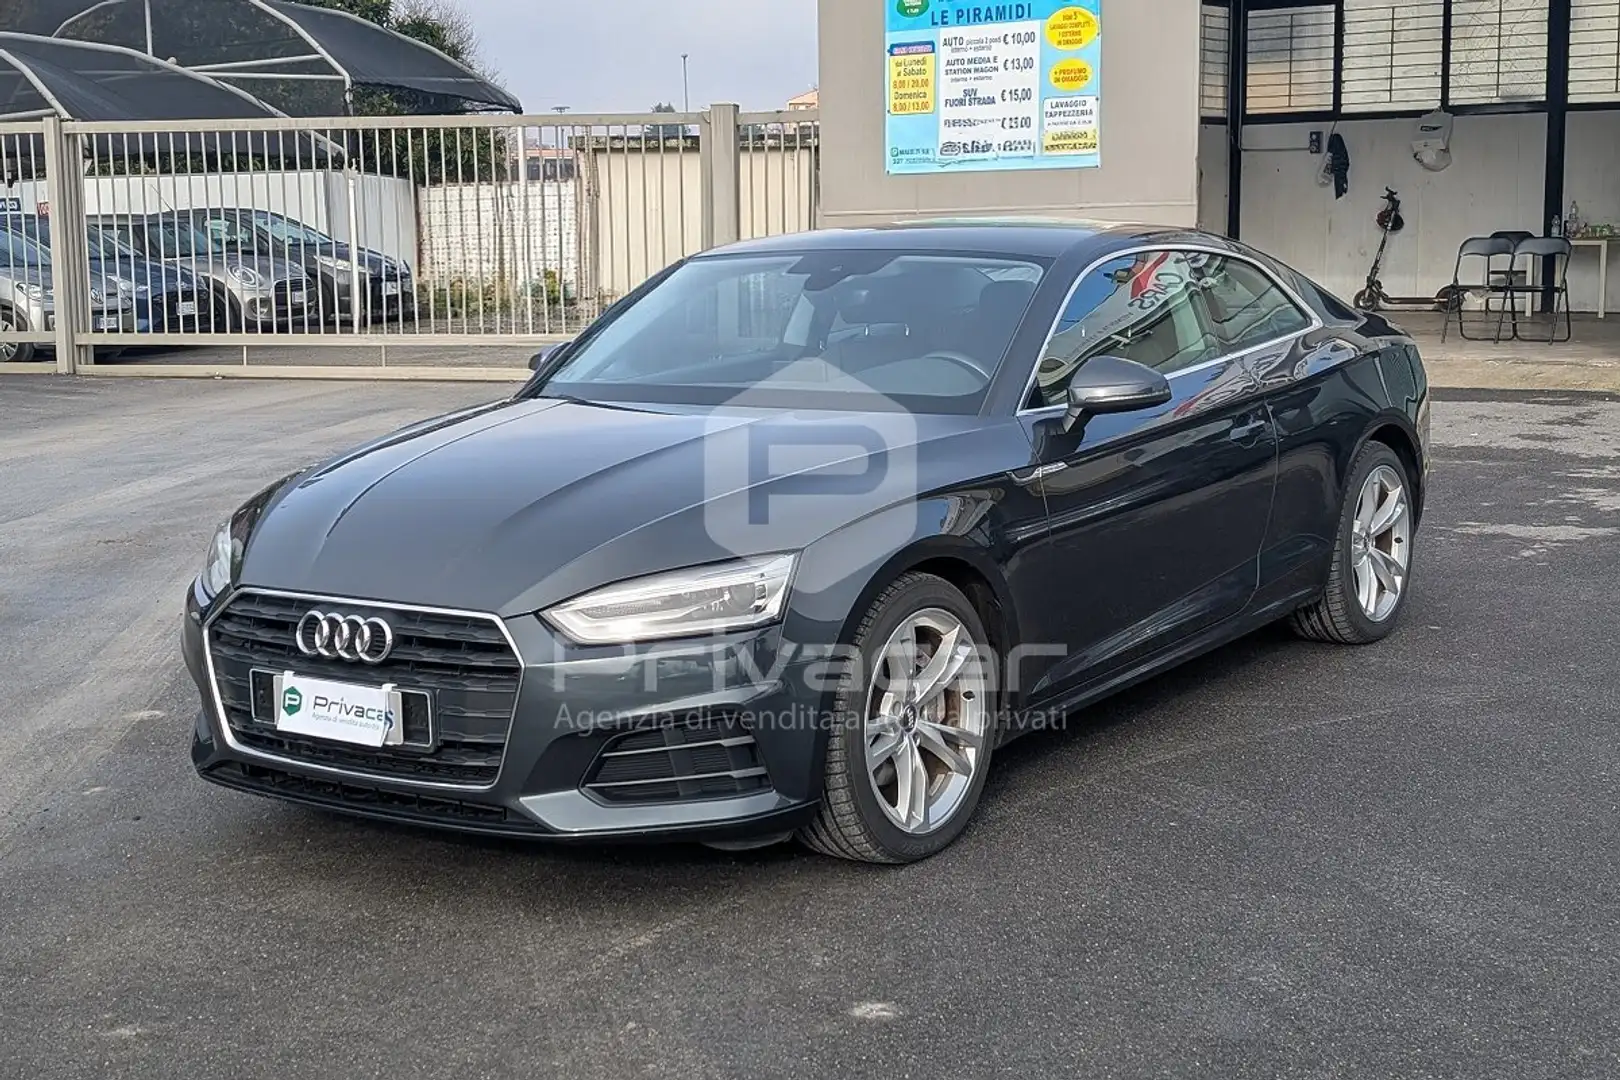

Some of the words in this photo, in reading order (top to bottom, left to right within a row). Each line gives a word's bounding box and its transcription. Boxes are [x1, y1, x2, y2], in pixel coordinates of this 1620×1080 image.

[931, 10, 949, 26] LE
[956, 3, 1032, 24] PIRAMIDI
[942, 37, 964, 47] AUTO
[1003, 33, 1009, 45] €
[1011, 31, 1035, 46] 10,00
[945, 58, 965, 67] AUTO
[967, 56, 991, 65] MEDIA
[993, 55, 998, 63] E
[945, 67, 972, 75] STATION
[1003, 59, 1009, 71] €
[1011, 56, 1034, 72] 13,00
[894, 90, 927, 100] Domenica
[944, 98, 967, 108] FUORI
[968, 95, 996, 107] STRADA
[962, 88, 978, 97] SUV
[1001, 89, 1007, 102] €
[1008, 87, 1032, 103] 15,00
[1050, 100, 1087, 109] LAVAGGIO
[1045, 109, 1093, 118] TAPPEZZERIA
